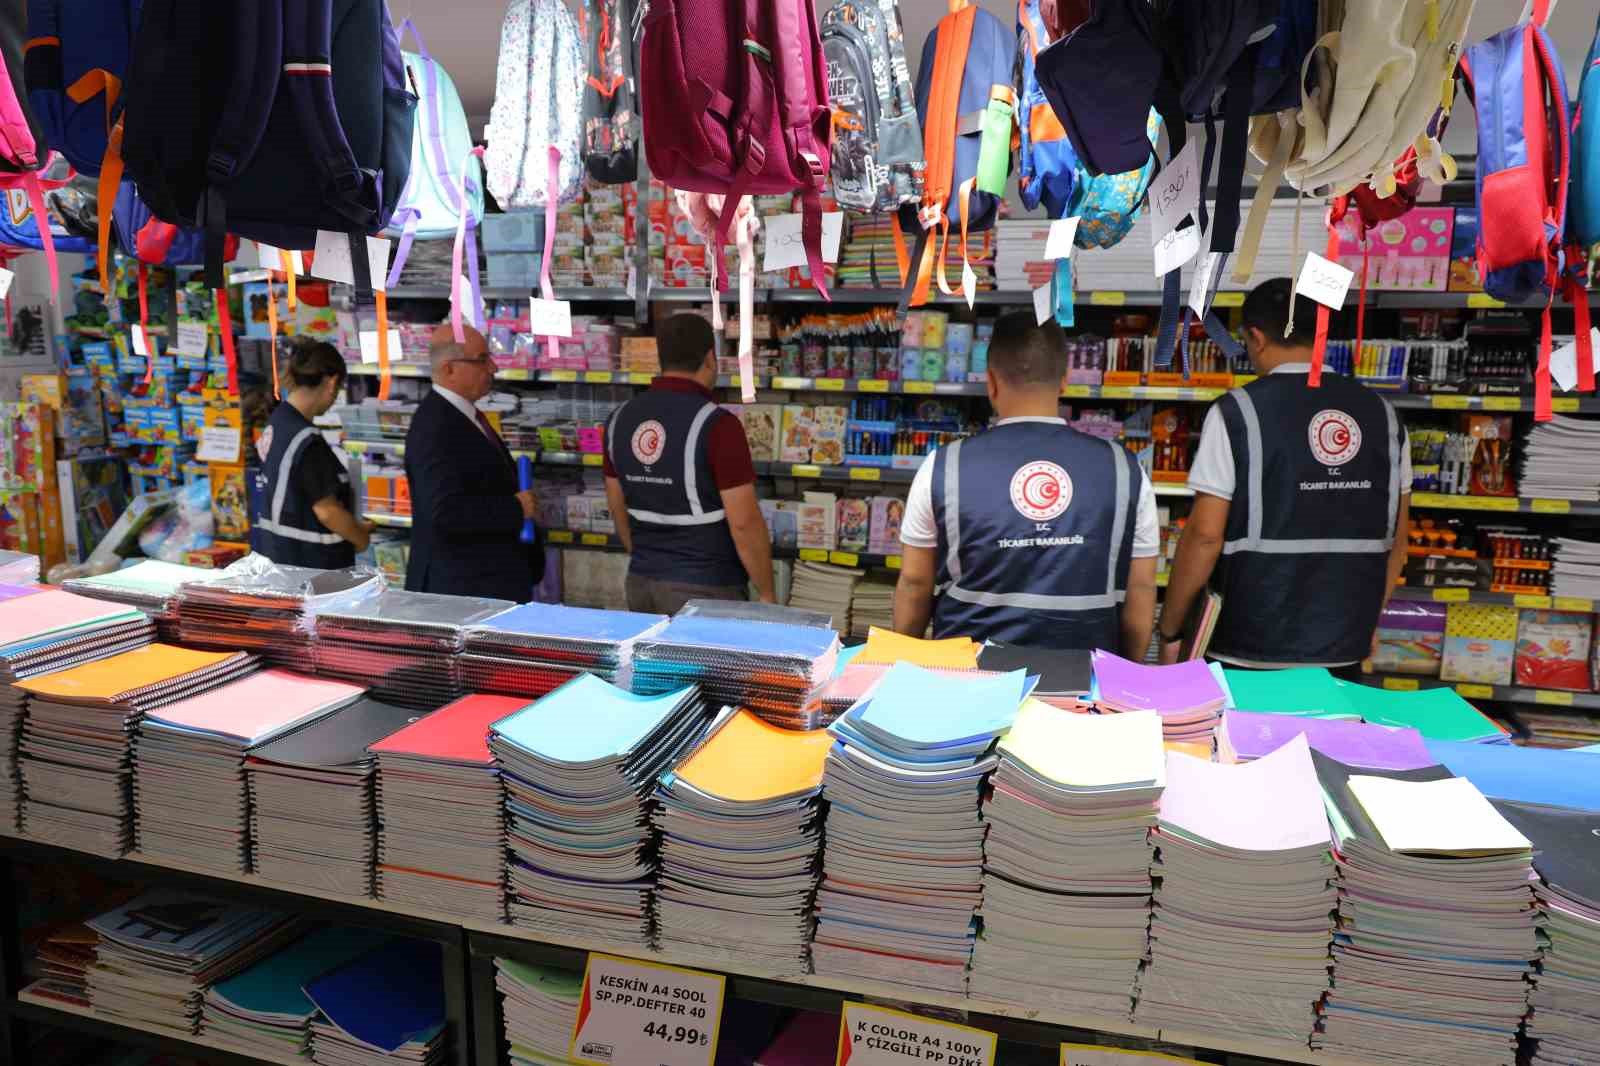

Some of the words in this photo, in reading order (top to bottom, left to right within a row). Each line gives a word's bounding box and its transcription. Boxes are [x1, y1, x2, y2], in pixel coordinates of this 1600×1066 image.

[1327, 467, 1341, 476] T.C.
[1300, 481, 1328, 490] TİCARET
[1329, 479, 1372, 489] BAKANLIĞI
[1035, 523, 1051, 531] T.C.
[998, 538, 1035, 548] TİCARET
[1036, 534, 1084, 547] BAKANLIĞI
[599, 974, 648, 993] KESKİN
[652, 984, 669, 996] A4
[595, 990, 685, 1015] SP.PP.DEFTER
[689, 1007, 706, 1018] 40
[858, 1021, 867, 1032] K
[871, 1024, 918, 1042] COLOR
[922, 1036, 940, 1047] A4
[945, 1040, 981, 1056] 100Y
[853, 1034, 862, 1044] P
[866, 1036, 921, 1058] ÇİZGİLİ
[926, 1051, 944, 1062] PP
